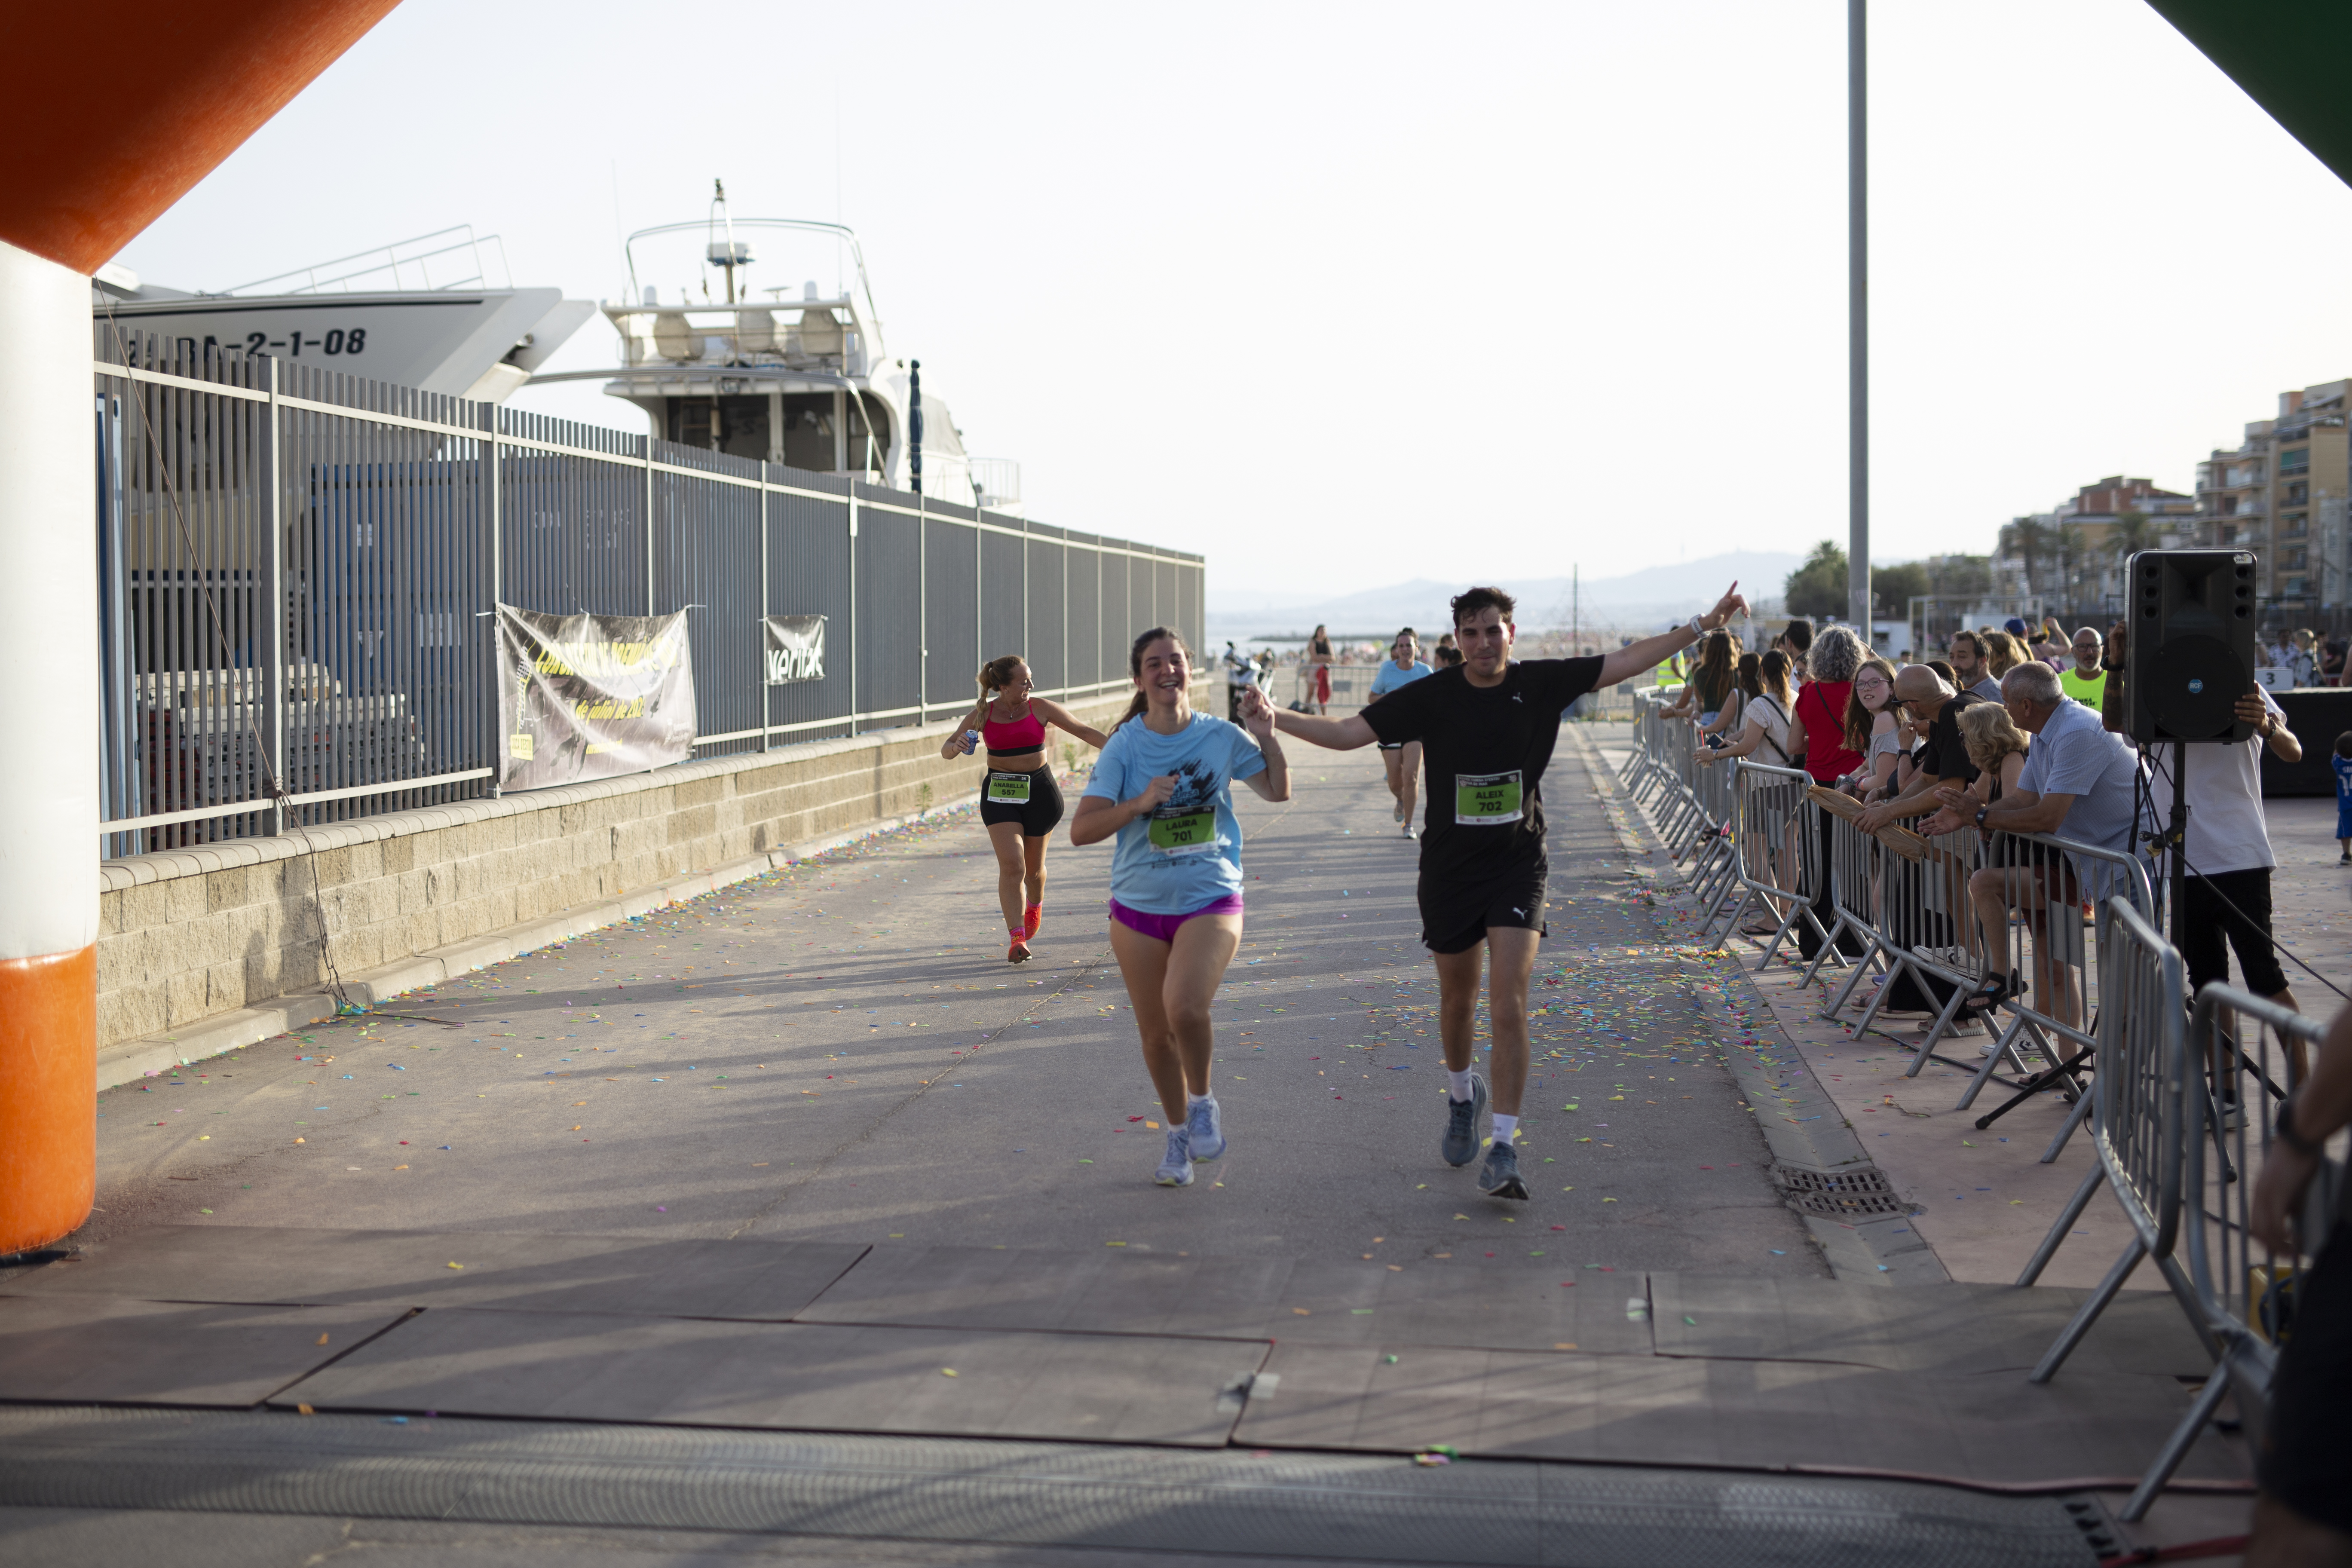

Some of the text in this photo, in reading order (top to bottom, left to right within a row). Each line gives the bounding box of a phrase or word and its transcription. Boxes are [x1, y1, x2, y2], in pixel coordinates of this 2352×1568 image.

[2266, 673, 2275, 684] 3
[576, 699, 589, 720] de
[585, 699, 618, 725] juliol
[614, 699, 628, 720] de
[1476, 790, 1504, 799] ALEIX
[1479, 801, 1502, 812] 702
[1166, 818, 1198, 831] LAURA
[1173, 830, 1192, 842] 701
